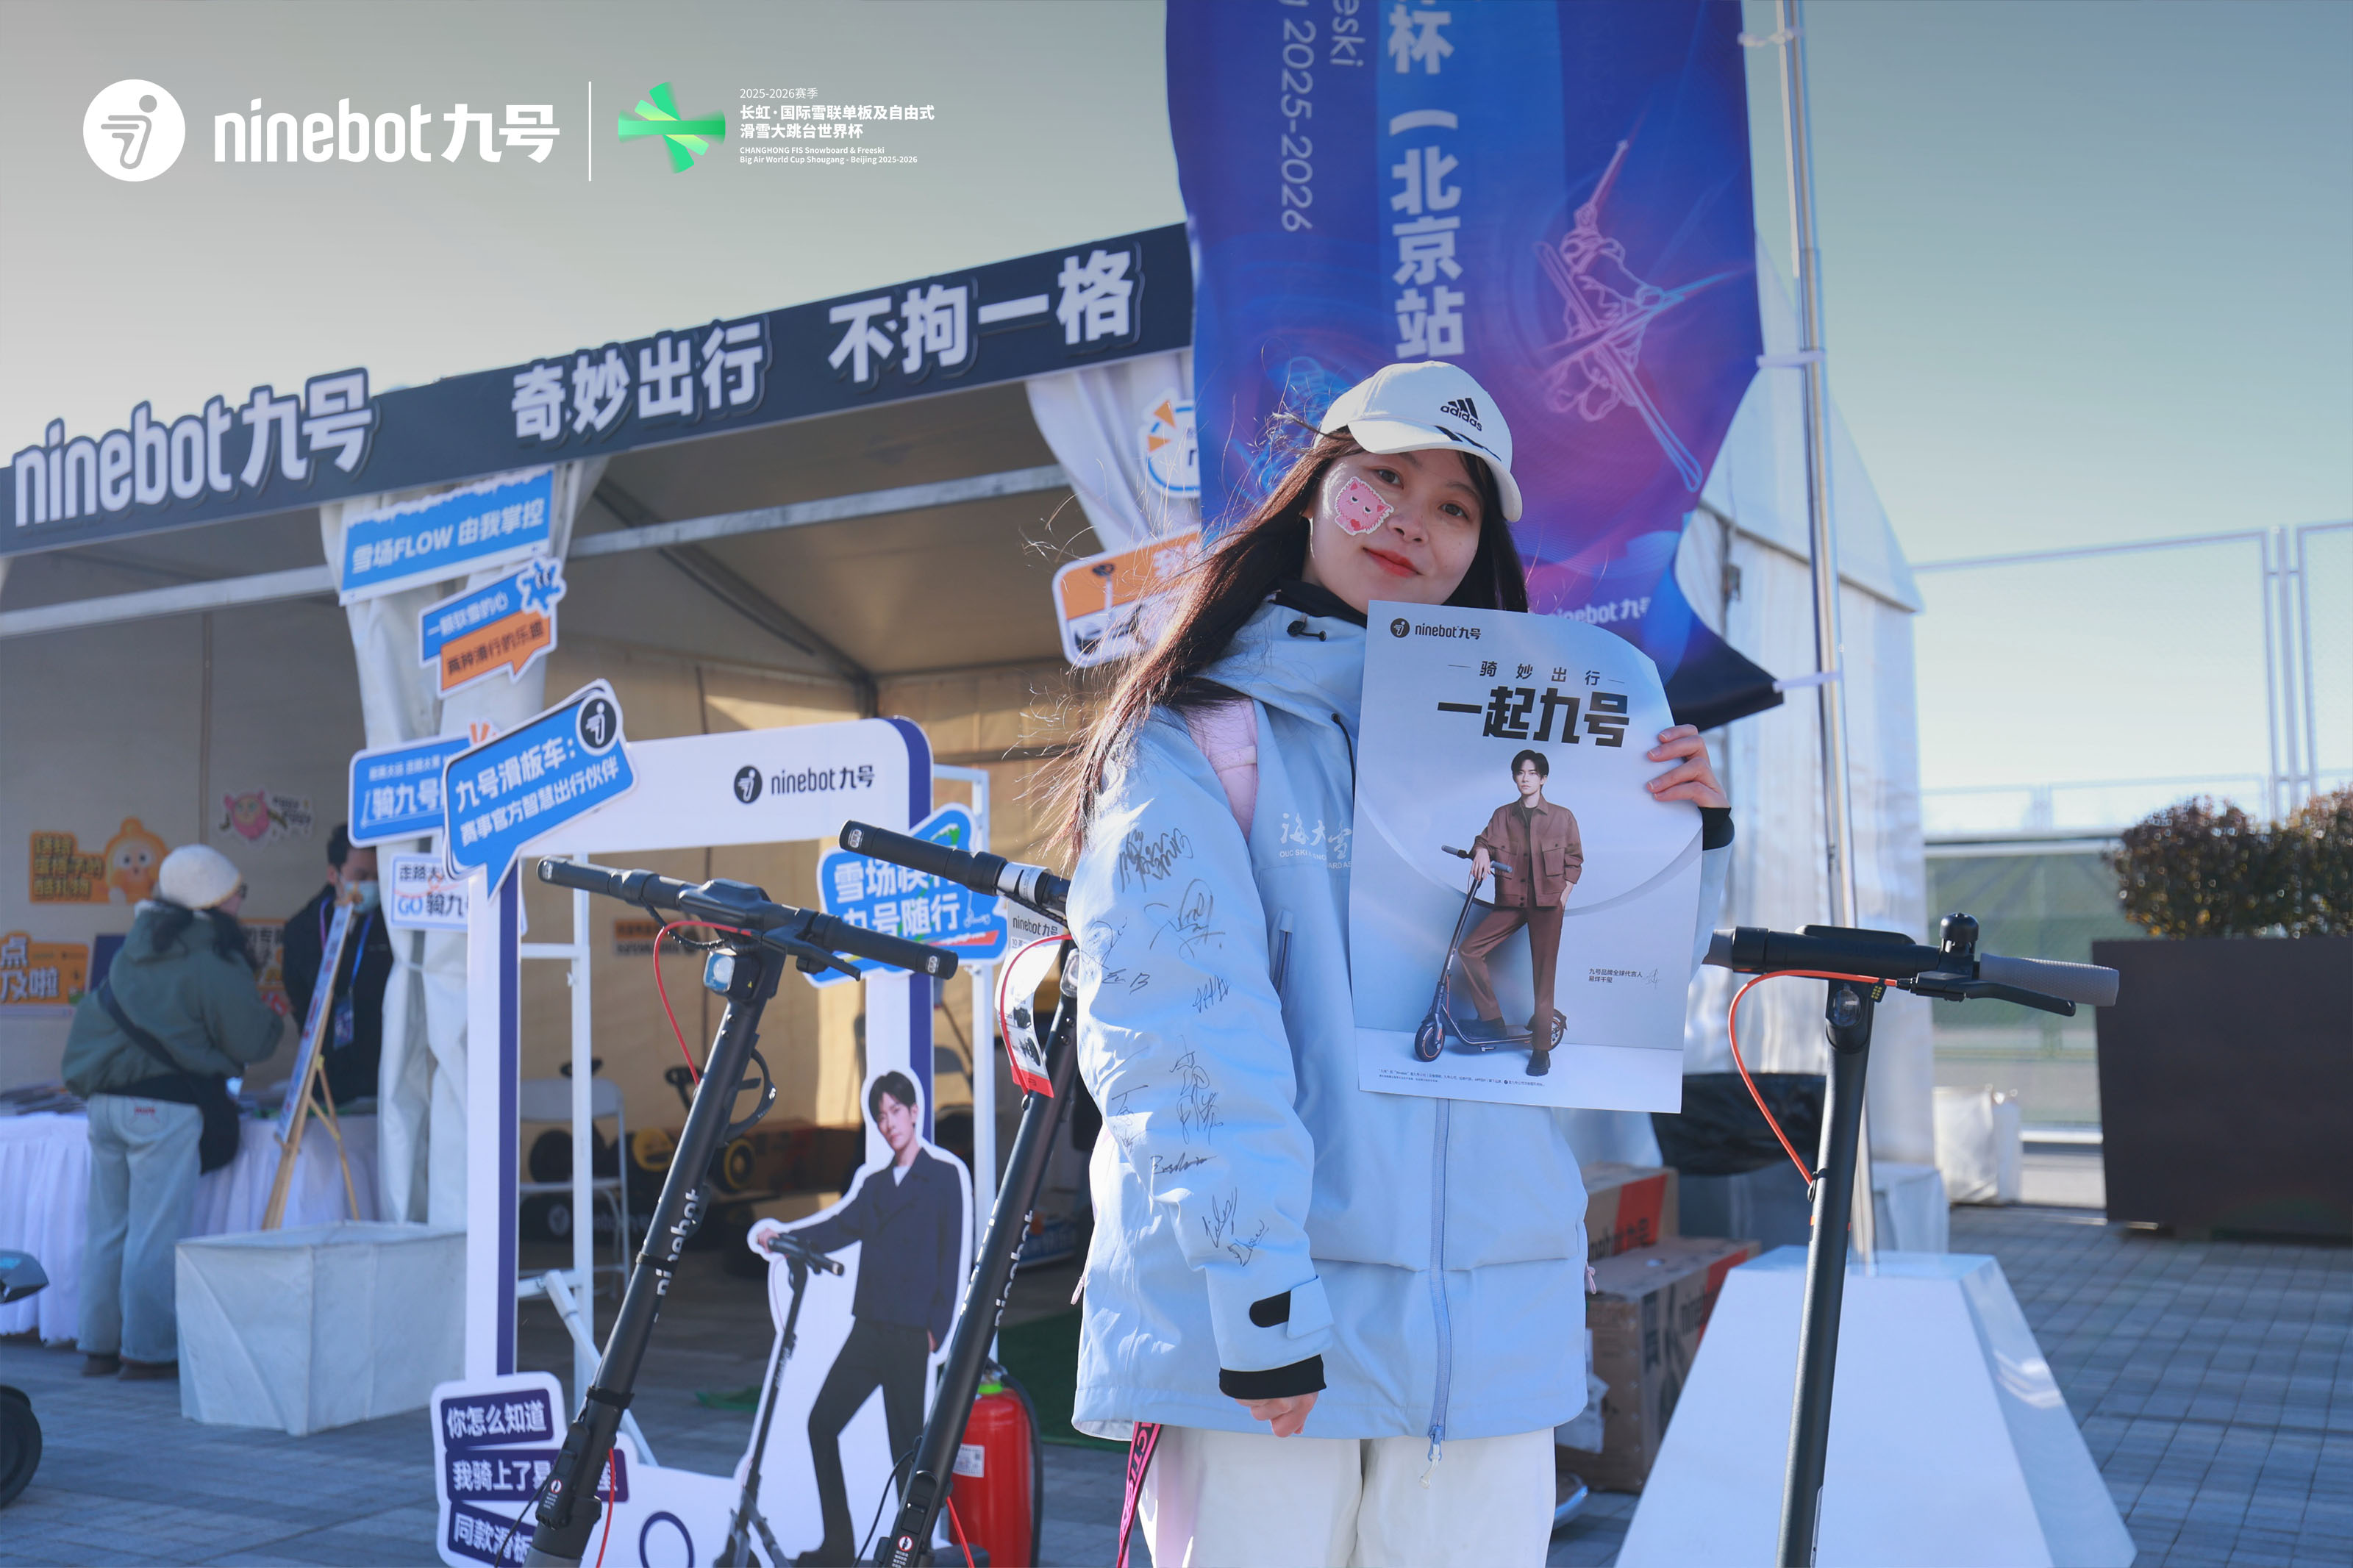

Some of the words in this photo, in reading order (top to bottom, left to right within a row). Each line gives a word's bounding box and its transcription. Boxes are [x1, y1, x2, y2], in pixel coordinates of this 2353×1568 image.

[1280, 18, 1316, 232] 2025-2026
[1387, 0, 1465, 359] 杯（北京站
[511, 322, 763, 441] 奇妙出行
[829, 250, 1135, 382] 不拘一格
[1440, 405, 1482, 432] adidas
[1437, 685, 1630, 748] 一起九号
[460, 756, 619, 847] 赛事官方智慧出行伙伴
[398, 898, 423, 916] GO
[426, 891, 468, 919] 骑九
[834, 857, 957, 903] 雪场快
[446, 1400, 547, 1439] 你怎么知道
